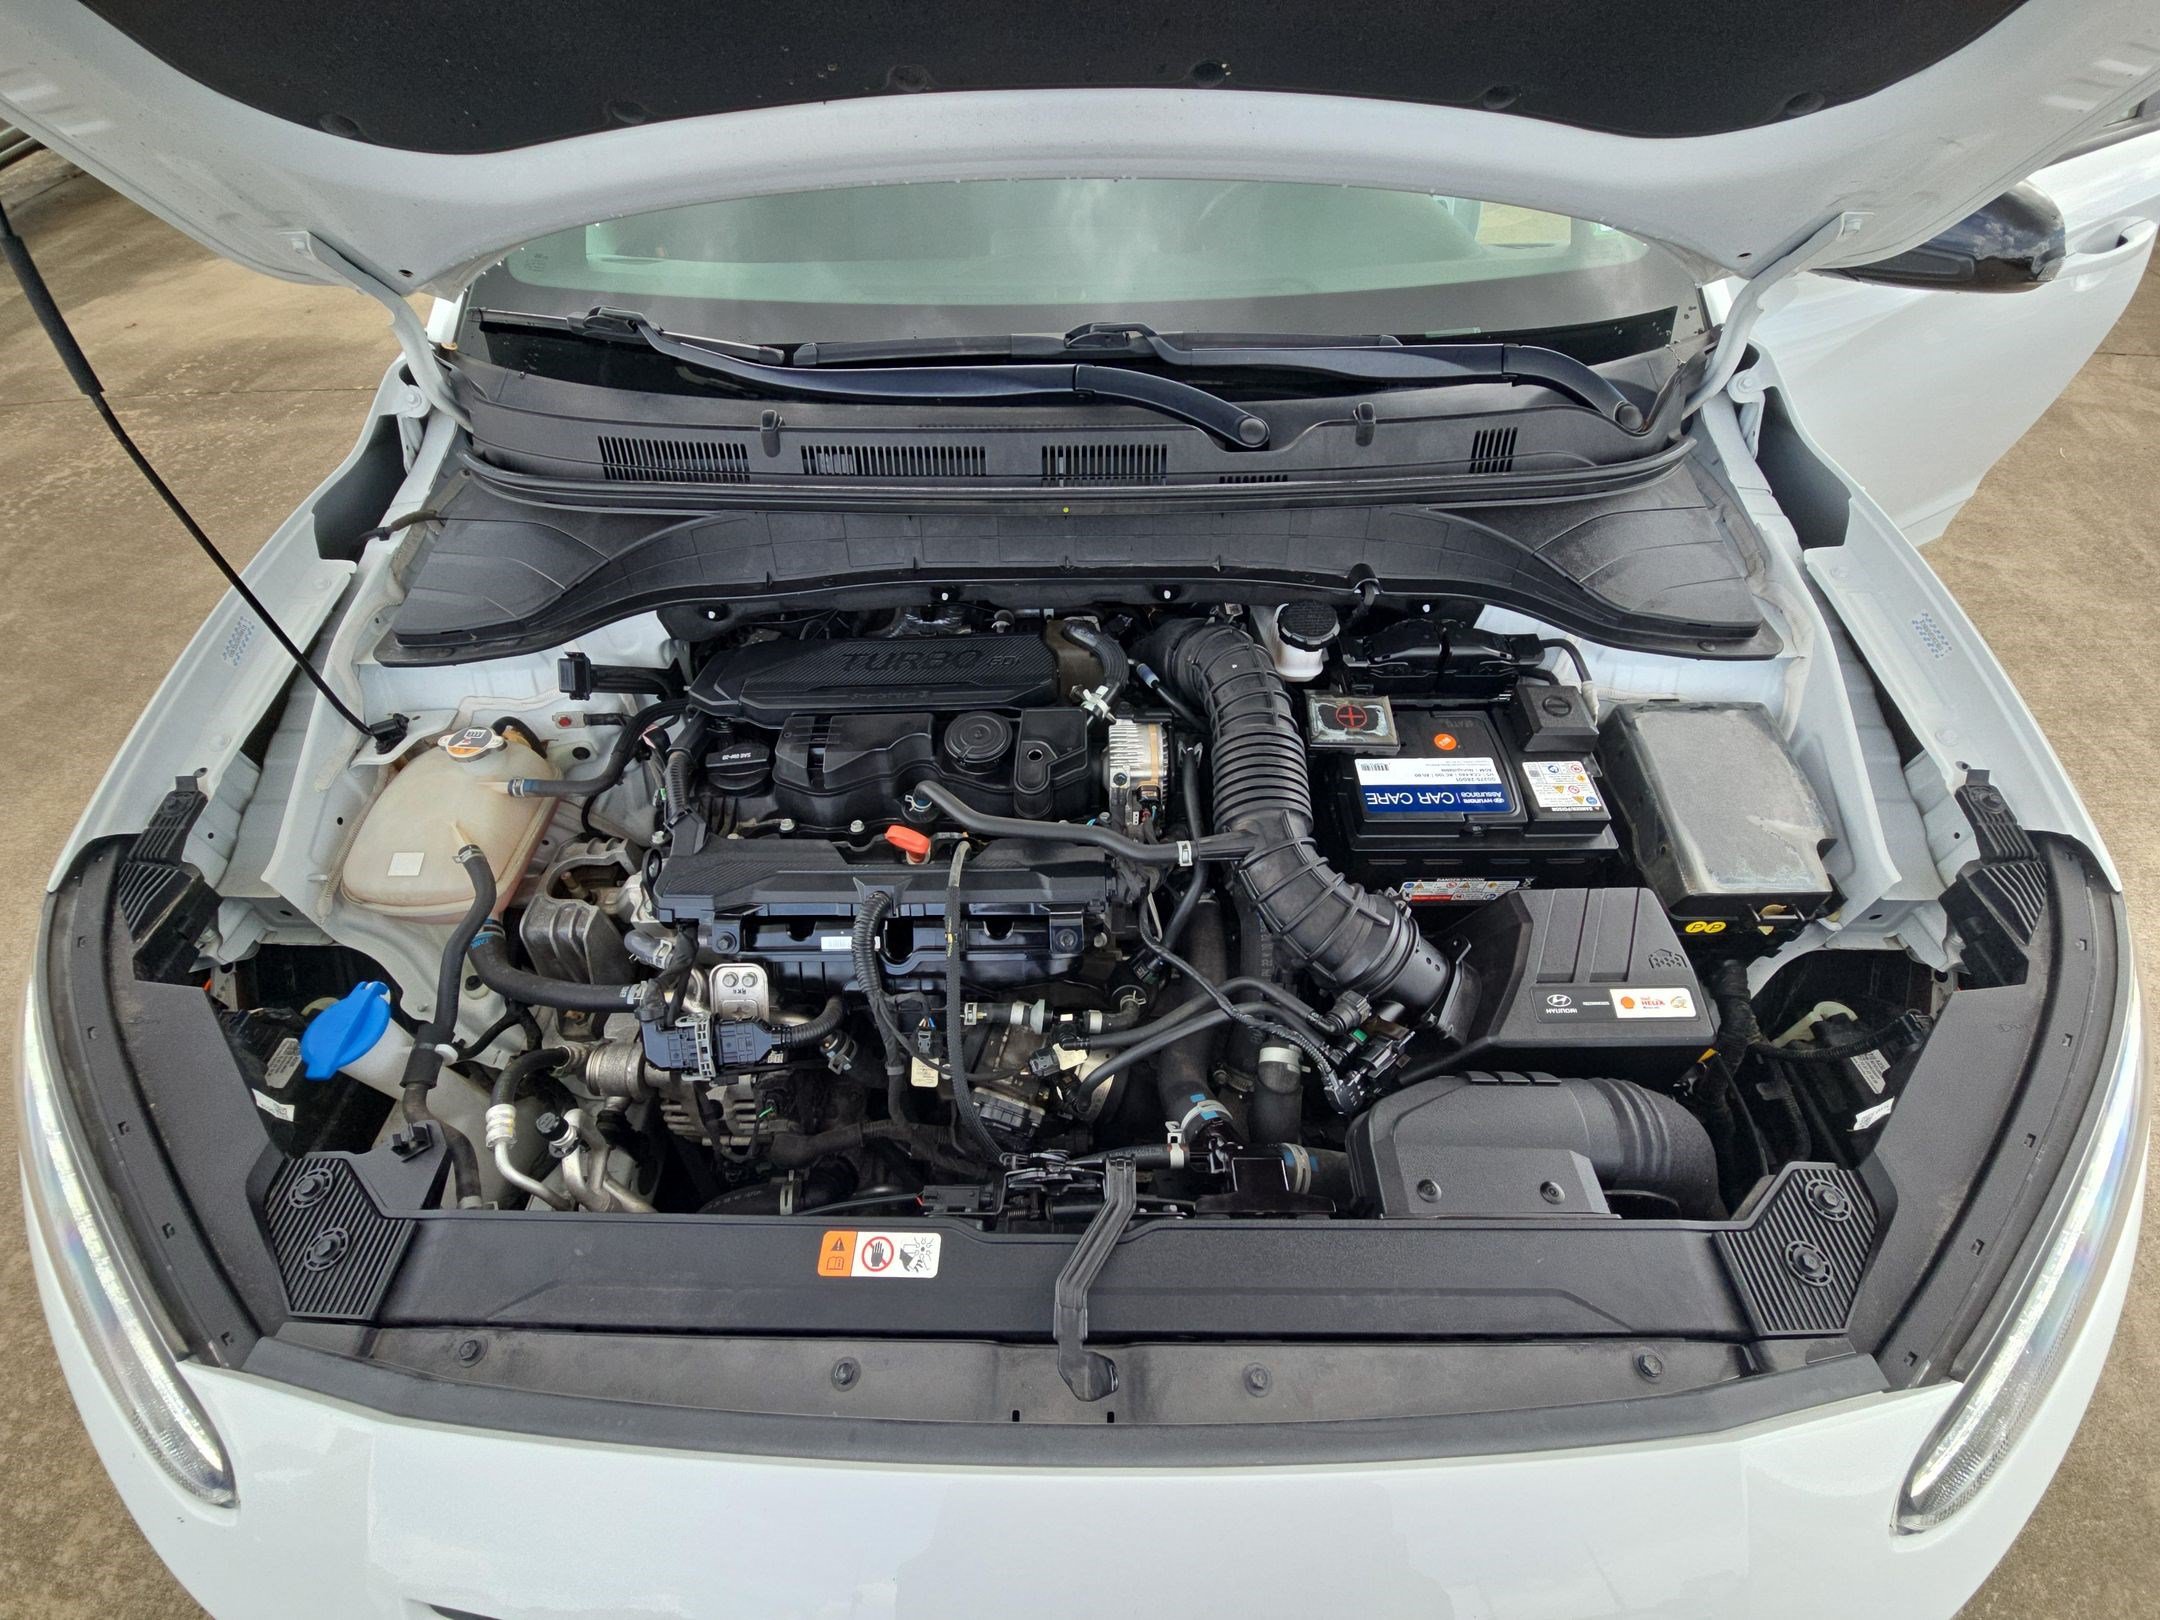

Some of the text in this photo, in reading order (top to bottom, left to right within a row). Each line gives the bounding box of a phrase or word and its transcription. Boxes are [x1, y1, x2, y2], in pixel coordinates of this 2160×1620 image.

[841, 650, 984, 672] TURBO
[1365, 791, 1455, 806] CAR CARE
